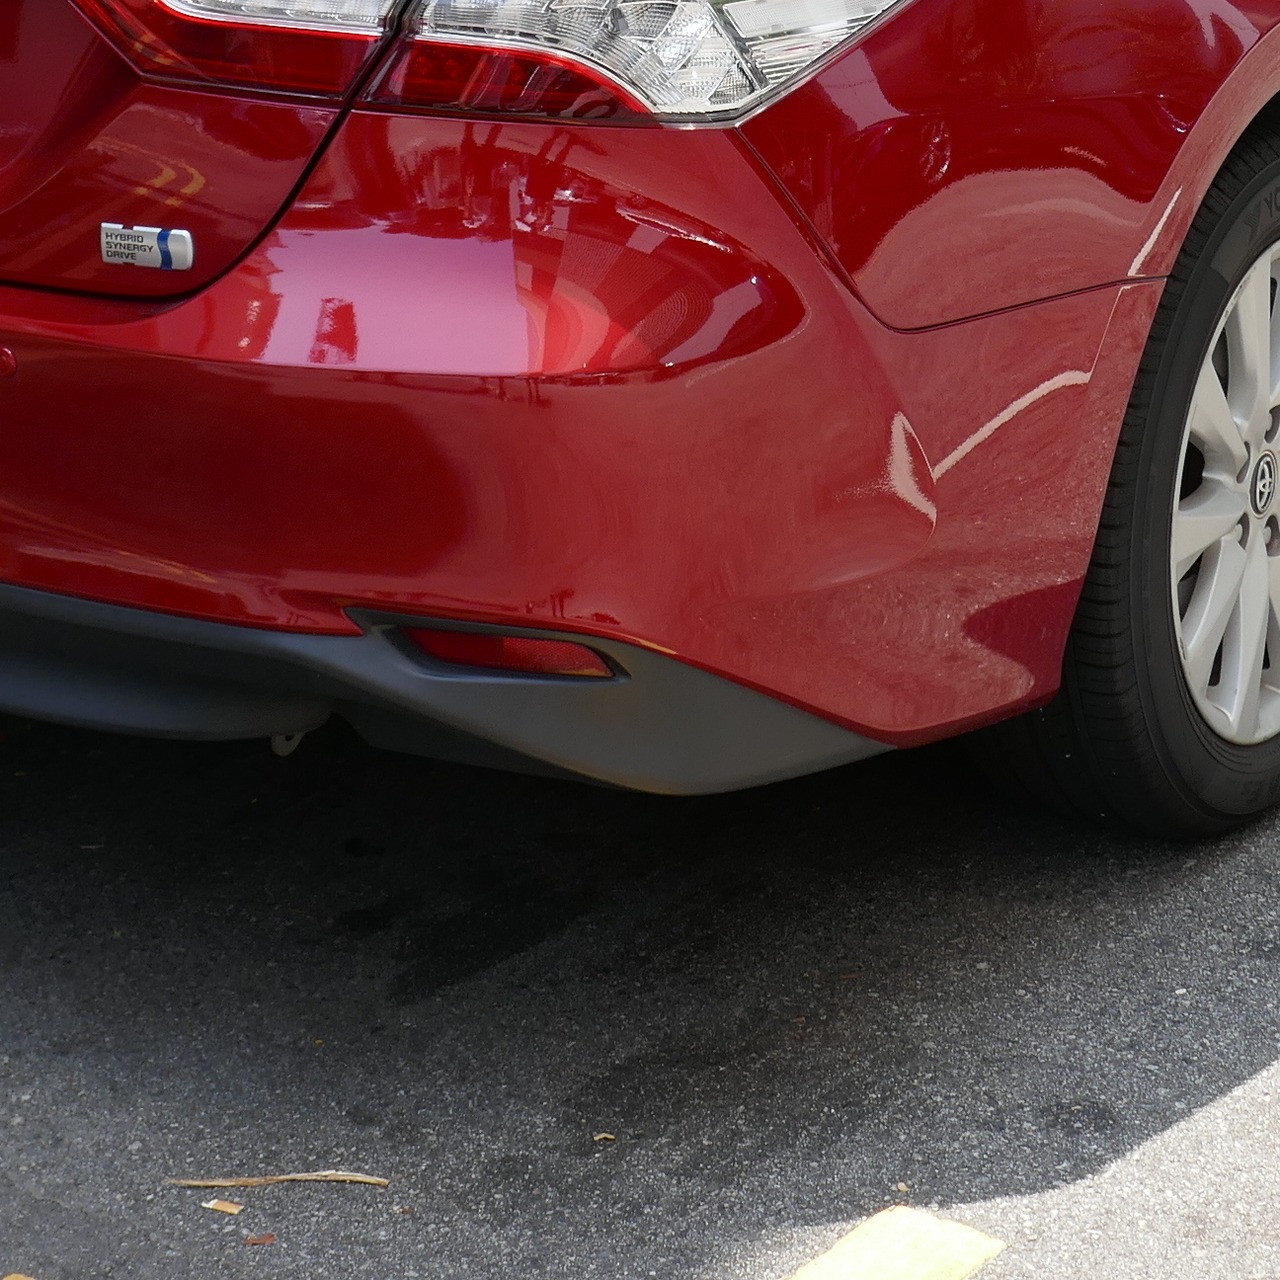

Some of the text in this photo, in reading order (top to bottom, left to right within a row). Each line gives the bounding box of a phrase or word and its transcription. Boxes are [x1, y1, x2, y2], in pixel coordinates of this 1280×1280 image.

[105, 232, 144, 243] HYBRID
[106, 241, 154, 253] SYNERGY
[106, 250, 137, 260] DRIVE
